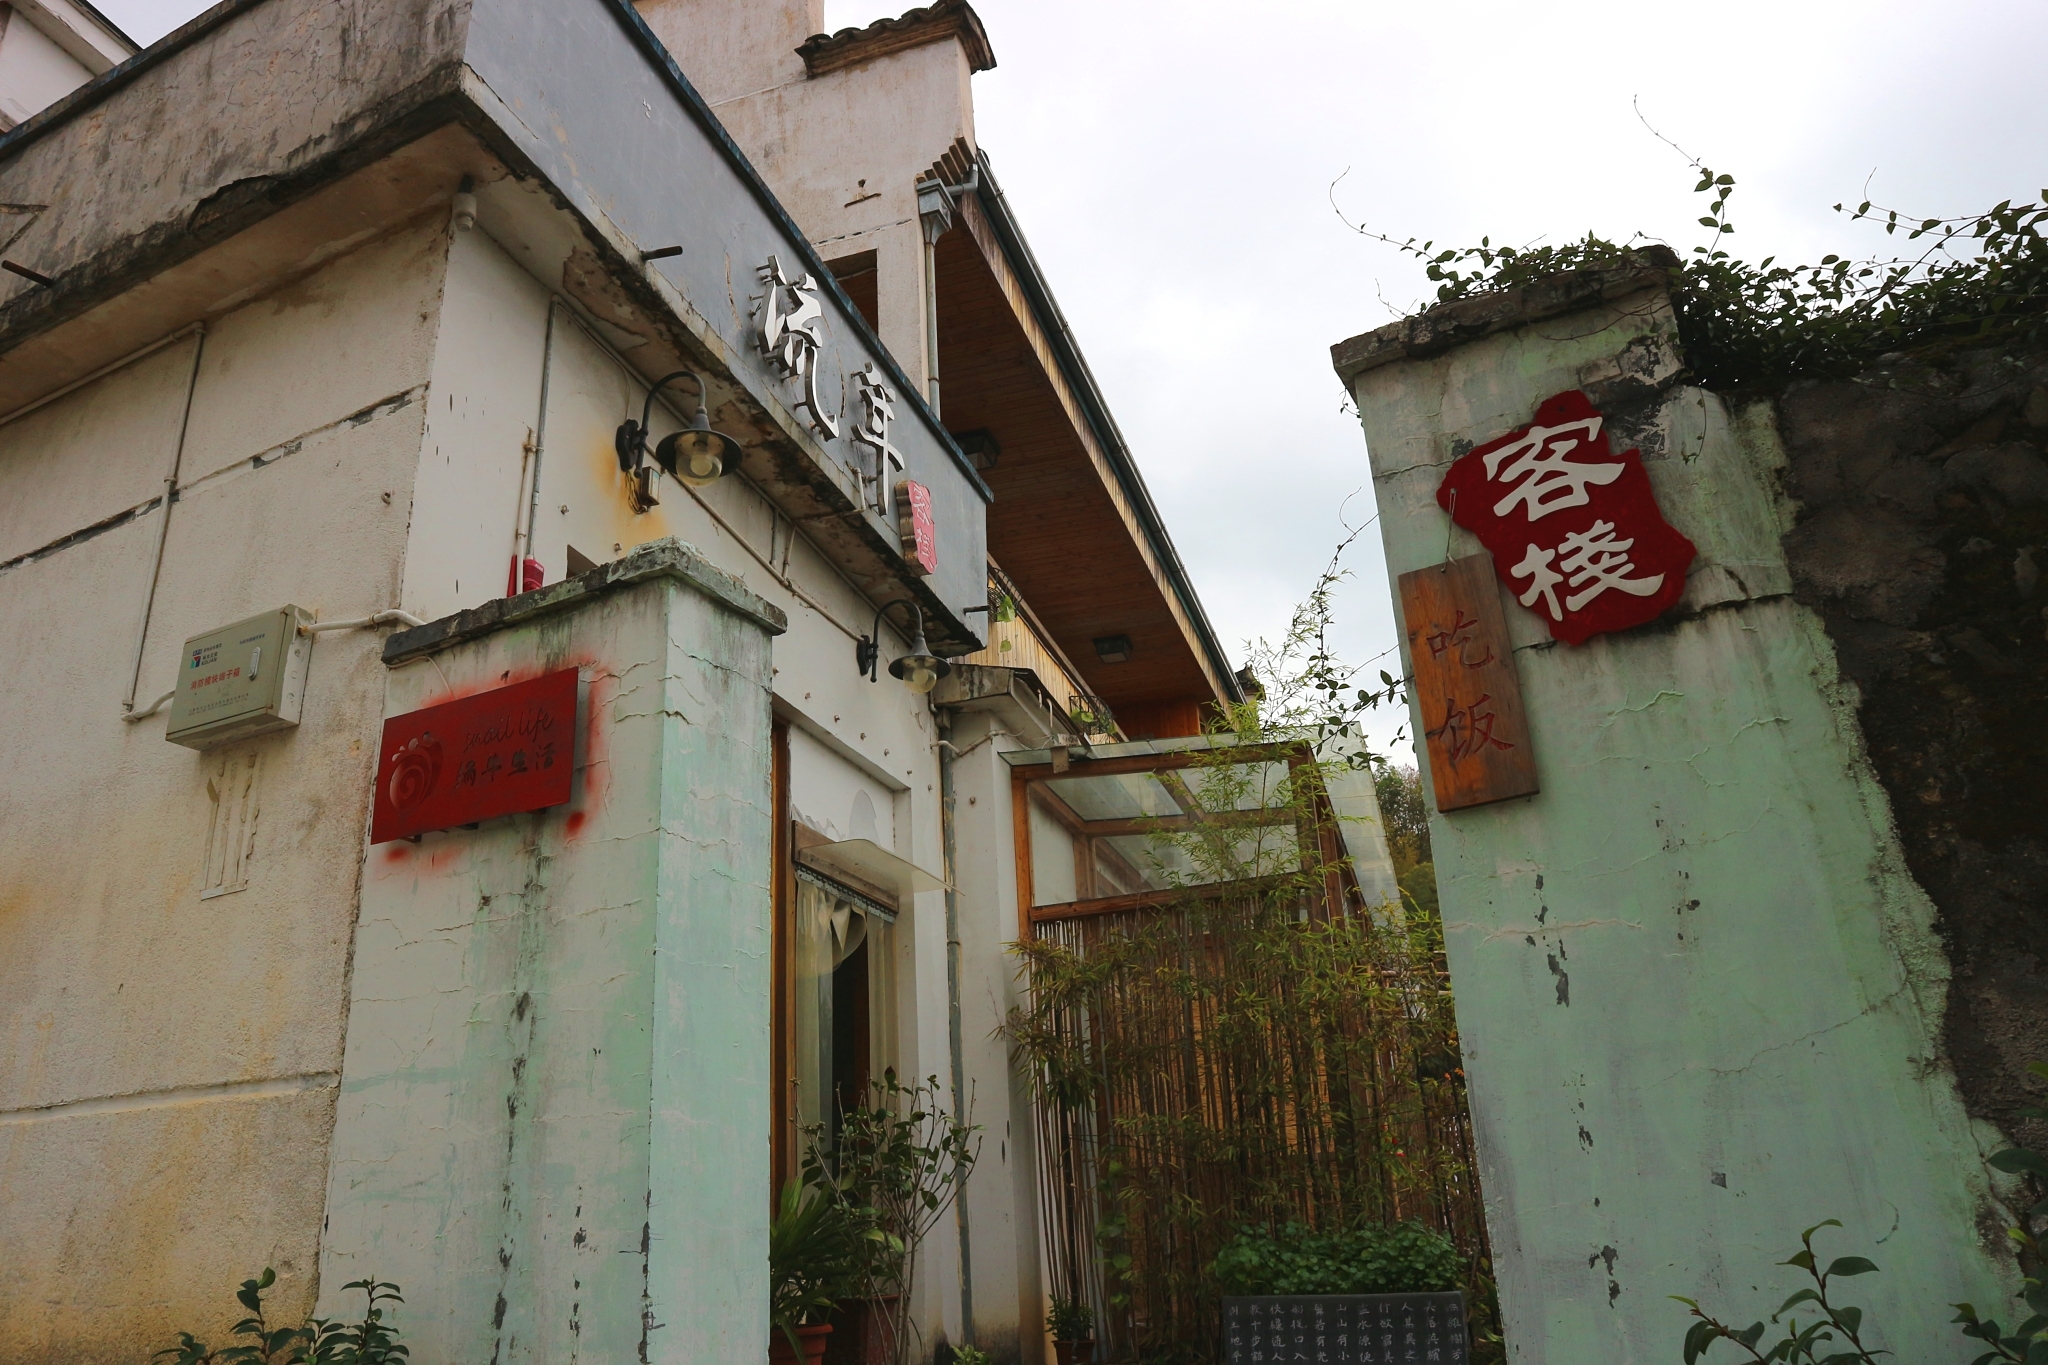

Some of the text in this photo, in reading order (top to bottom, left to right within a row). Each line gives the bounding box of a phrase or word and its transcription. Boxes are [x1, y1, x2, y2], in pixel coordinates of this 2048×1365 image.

[190, 667, 241, 690] 消防模块端子箱
[1426, 609, 1516, 762] 吃饭
[518, 706, 555, 743] life
